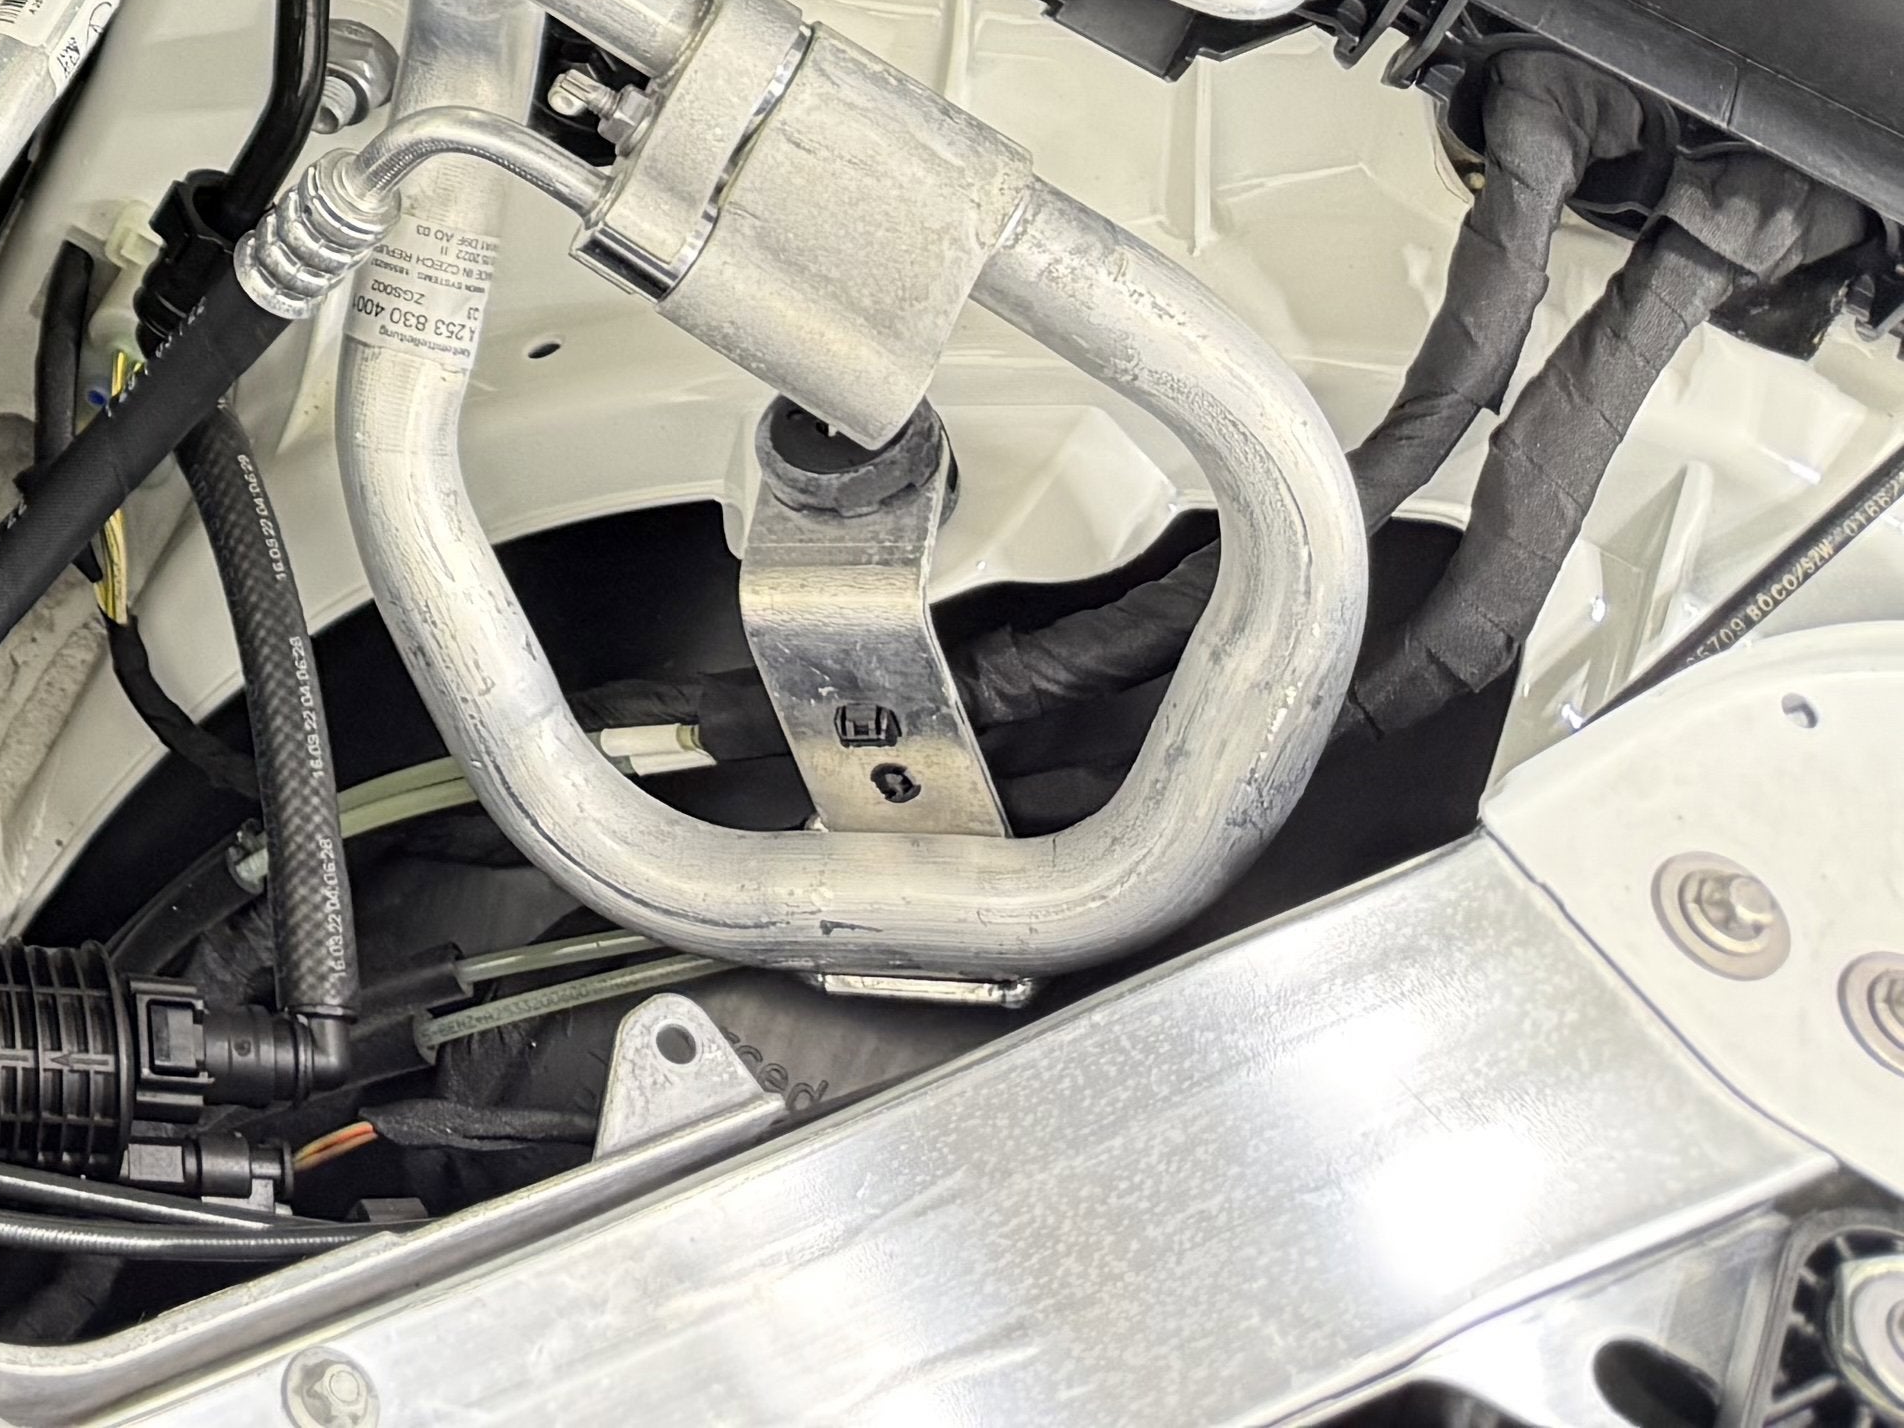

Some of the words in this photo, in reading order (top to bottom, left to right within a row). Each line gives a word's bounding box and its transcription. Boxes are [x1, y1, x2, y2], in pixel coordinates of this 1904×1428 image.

[414, 254, 460, 275] CZECH
[369, 278, 425, 305] ZGS002
[415, 271, 462, 290] SYSTEMS
[388, 306, 428, 332] 830
[432, 317, 466, 341] 253
